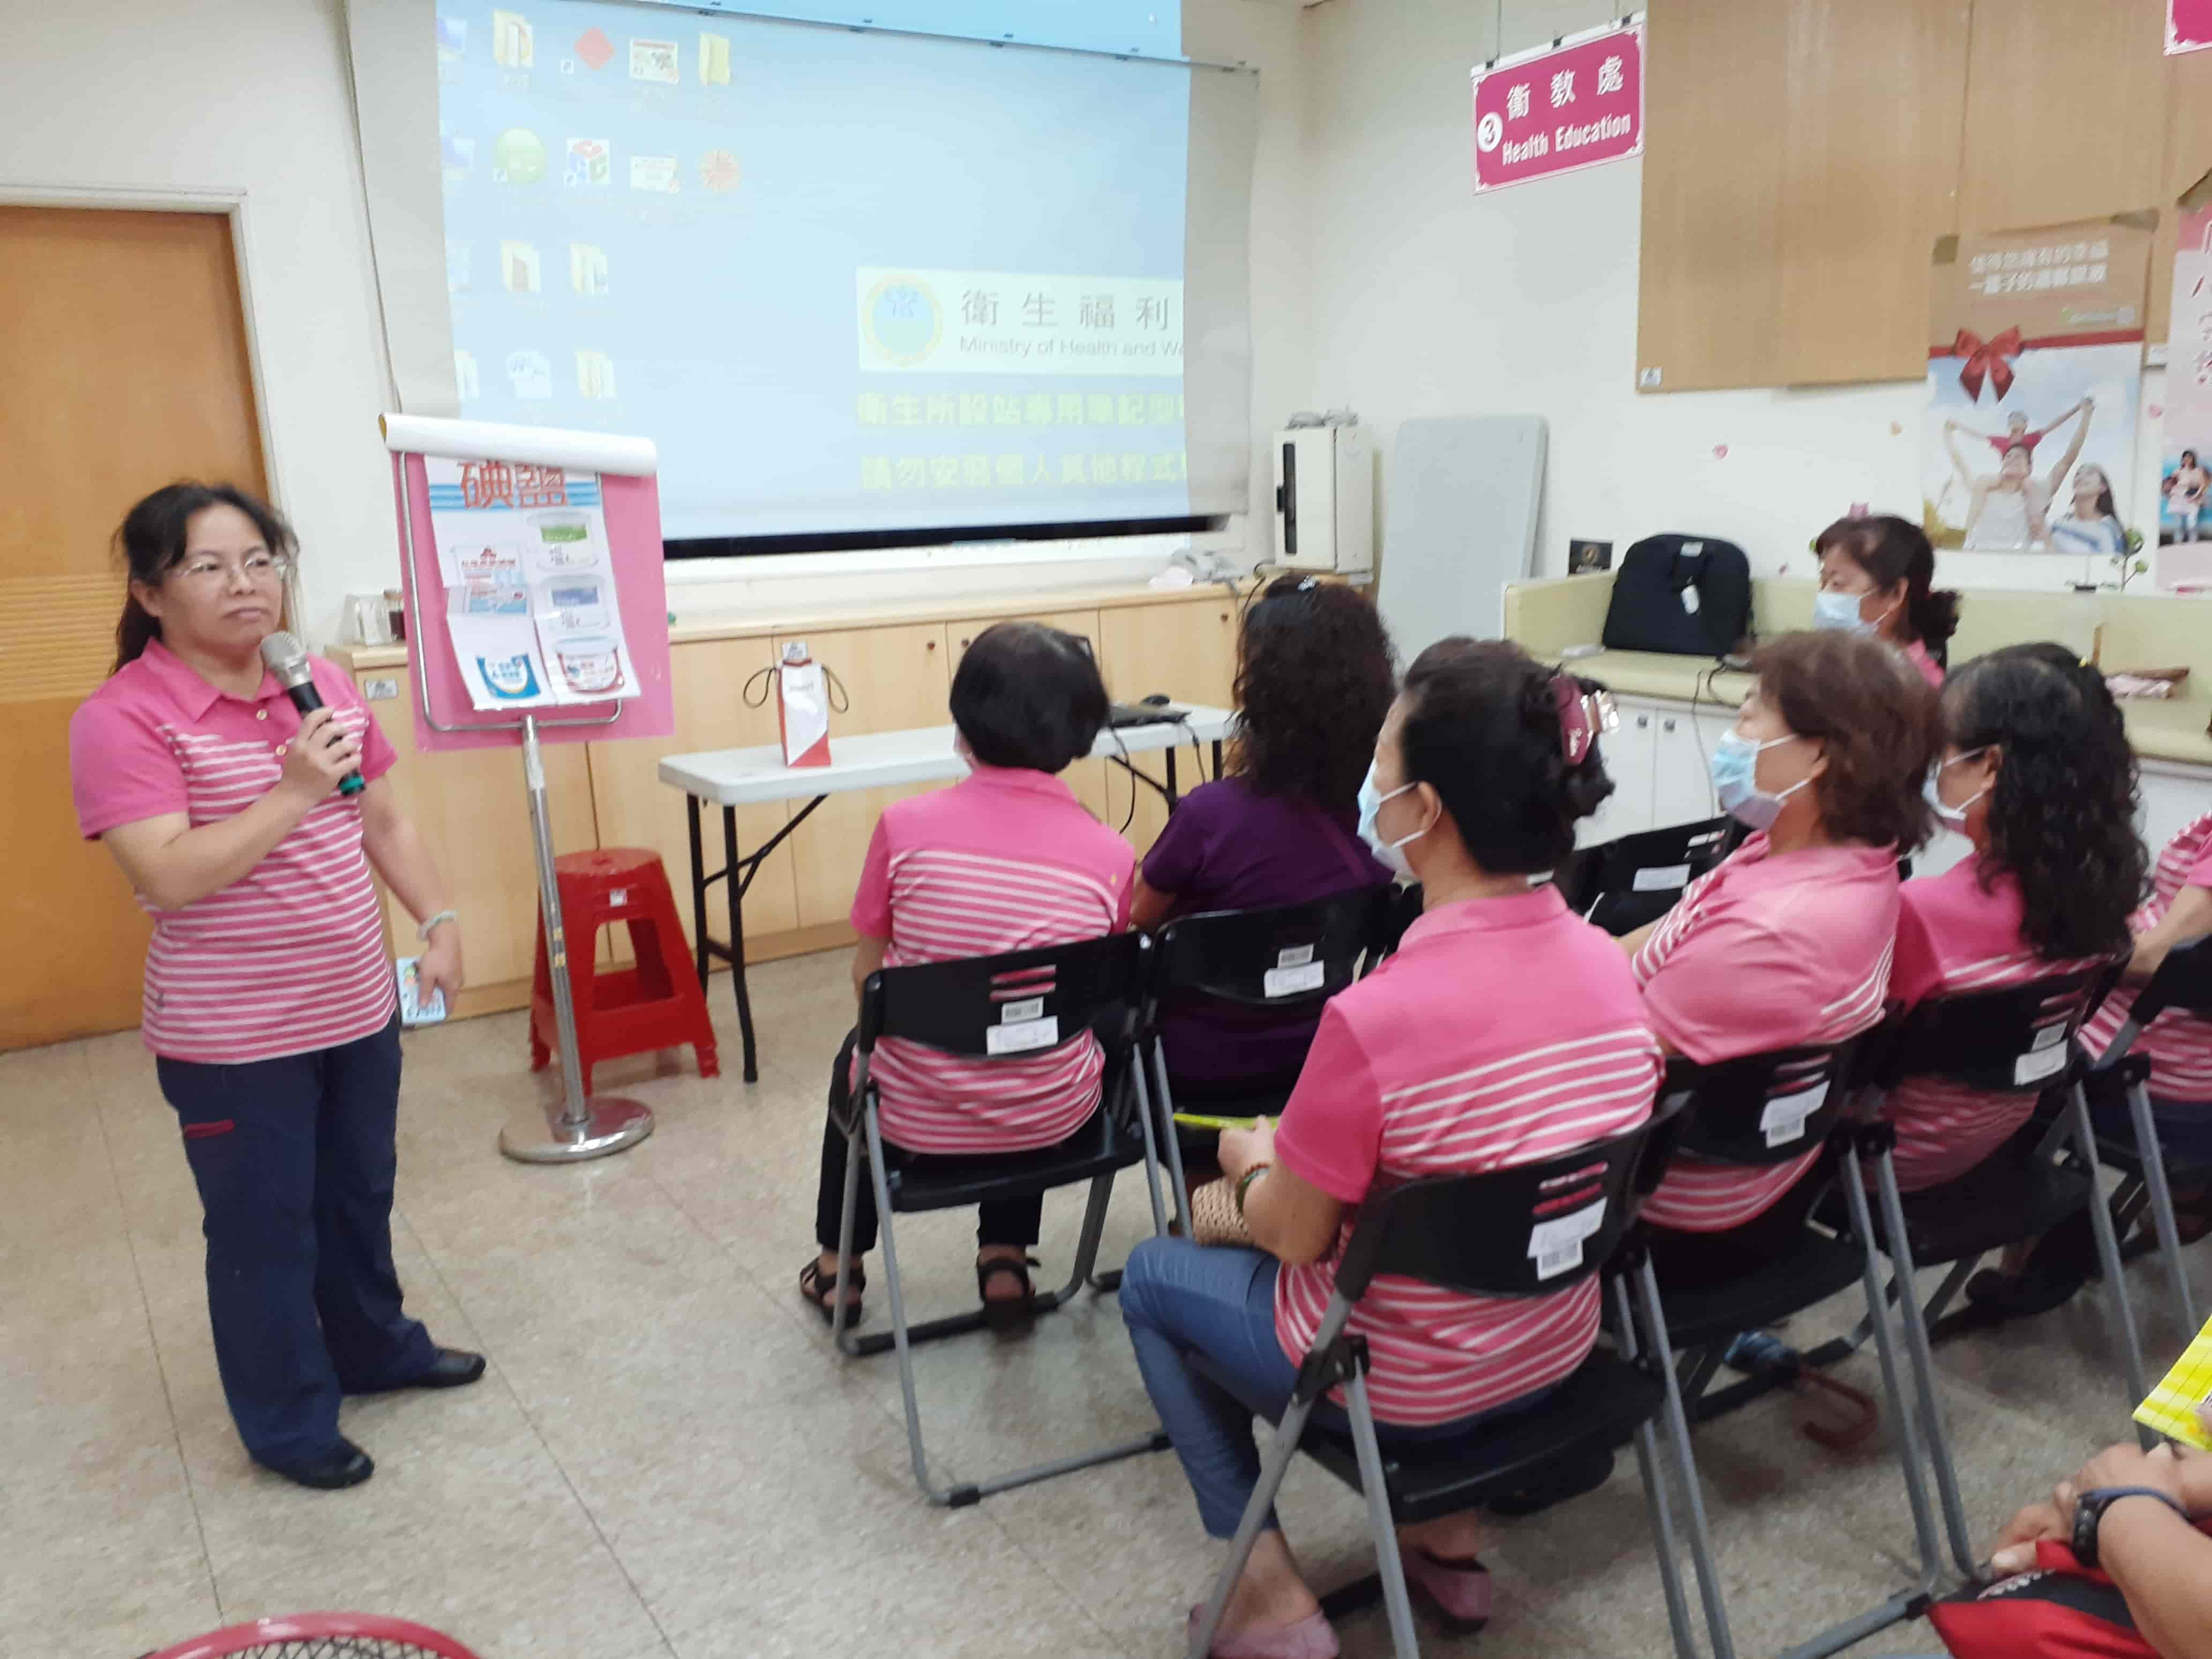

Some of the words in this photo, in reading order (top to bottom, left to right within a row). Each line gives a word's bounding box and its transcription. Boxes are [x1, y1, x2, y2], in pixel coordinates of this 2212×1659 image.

[1506, 55, 1624, 121] 衛教處
[1502, 130, 1549, 166] Health
[1555, 113, 1631, 153] Education
[961, 290, 1170, 331] 衛生福利
[960, 335, 1032, 358] Ministry
[1037, 339, 1055, 355] of
[1060, 339, 1117, 356] Health
[1123, 340, 1156, 356] and
